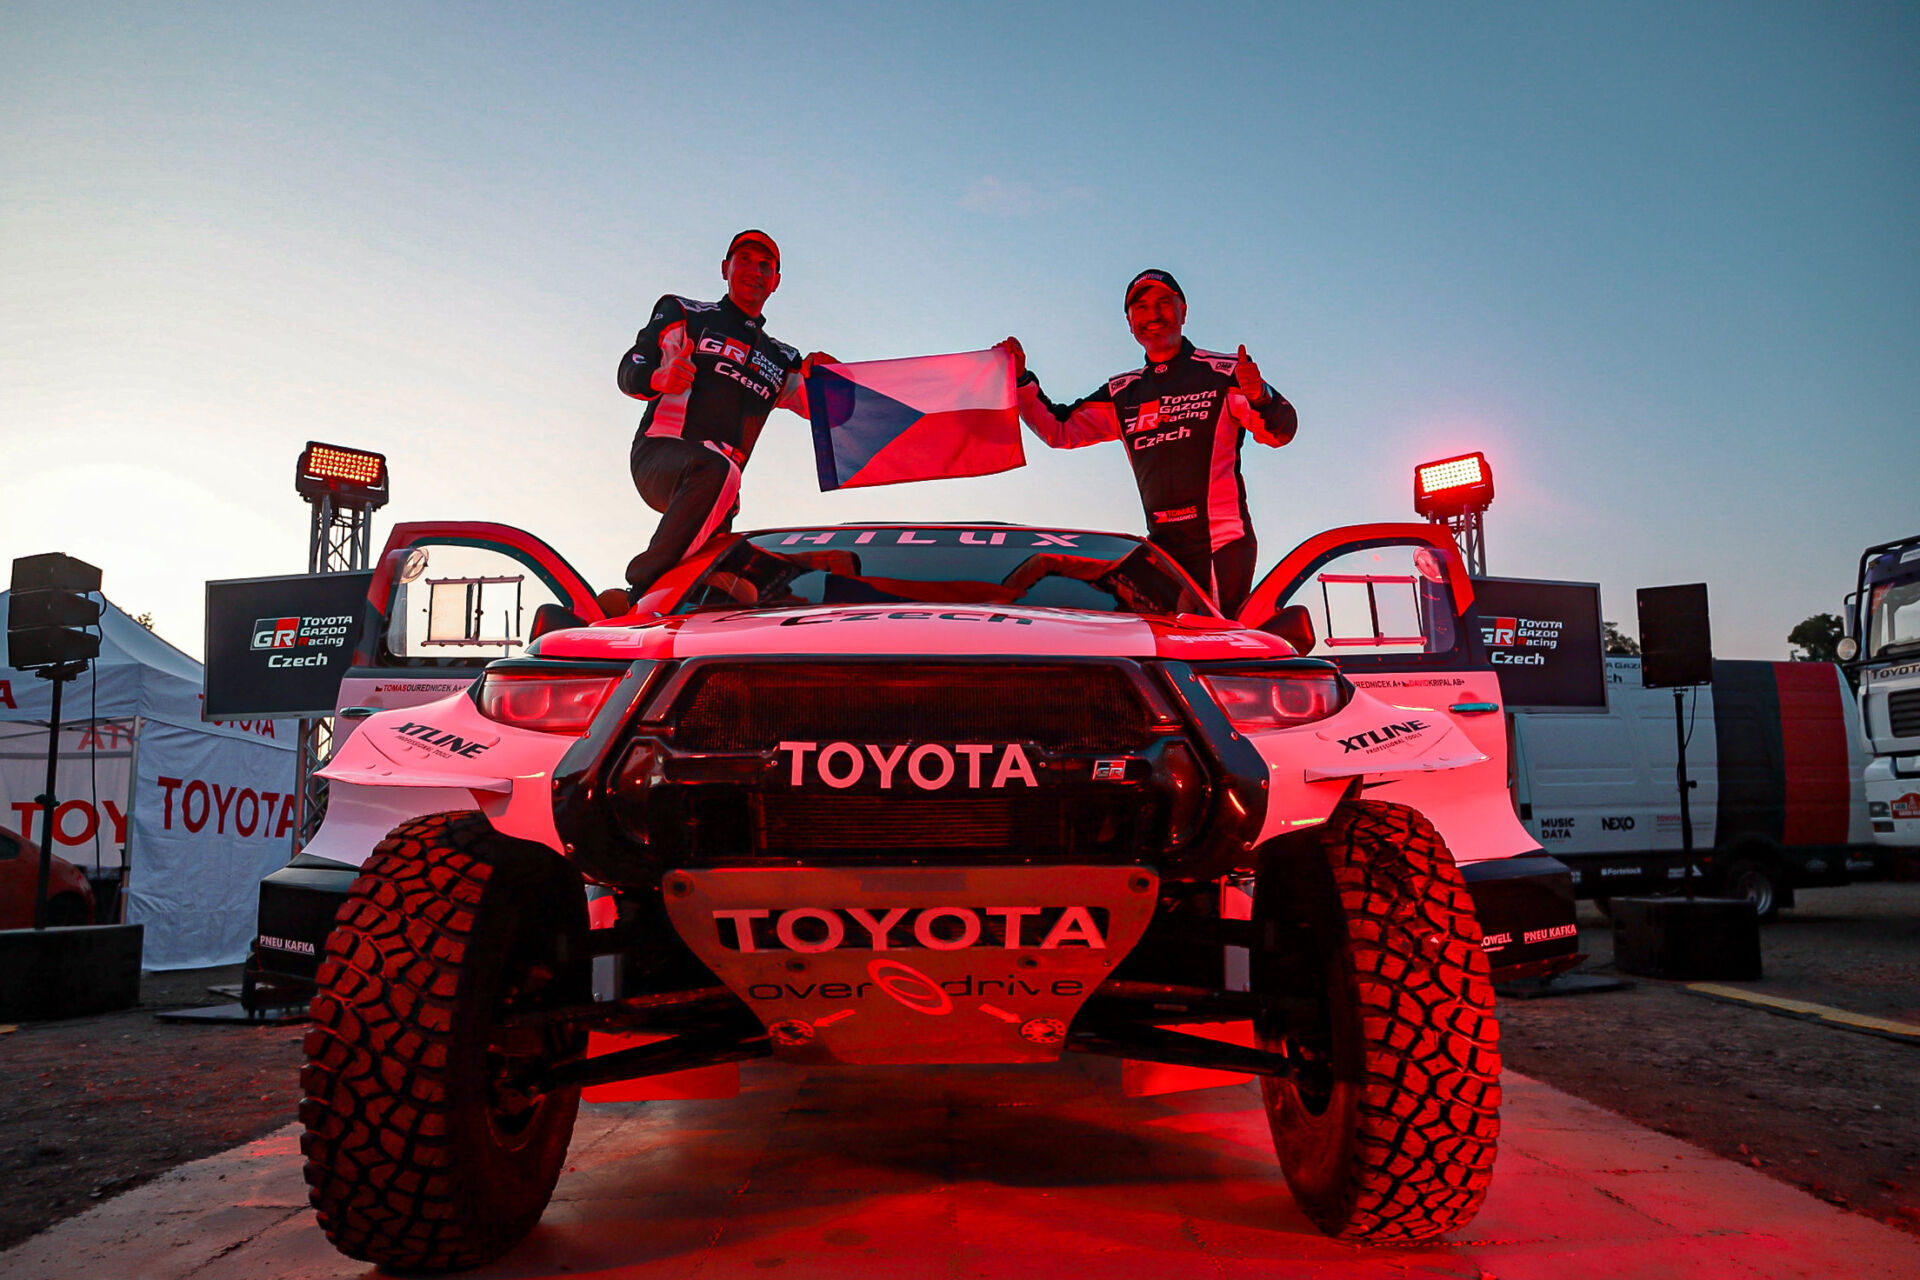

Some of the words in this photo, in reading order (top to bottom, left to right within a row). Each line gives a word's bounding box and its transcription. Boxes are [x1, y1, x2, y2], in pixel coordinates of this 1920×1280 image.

[699, 338, 746, 364] GR
[714, 361, 770, 399] Czech
[1161, 390, 1217, 405] TOYOTA
[1160, 401, 1211, 413] GAZOO
[1157, 410, 1208, 423] Racing
[781, 531, 1080, 547] HILUX
[302, 616, 353, 626] TOYOTA
[780, 611, 1033, 626] Czech
[1519, 619, 1563, 629] TOYOTA
[253, 630, 295, 647] GR
[300, 626, 346, 636] GAZOO
[1518, 628, 1558, 637] GAZOO
[298, 636, 344, 647] Racing
[1517, 638, 1557, 649] Racing
[268, 653, 328, 668] Czech
[1491, 652, 1545, 665] Czech
[1871, 663, 1920, 680] TOYOT
[391, 722, 489, 758] XTLINE
[1337, 719, 1429, 753] XTLINE
[780, 741, 1038, 790] TOYOTA
[1097, 767, 1123, 777] GR
[1541, 818, 1575, 827] MUSIC
[1602, 816, 1635, 831] NEXO
[1542, 829, 1572, 839] DATA
[712, 905, 1106, 953] TOYOTA
[1523, 930, 1548, 942] PNEU
[1548, 924, 1577, 938] KAFKA
[260, 935, 283, 948] PNEU
[284, 939, 315, 953] KAFKA
[748, 979, 874, 999] over
[940, 975, 1083, 998] drive
